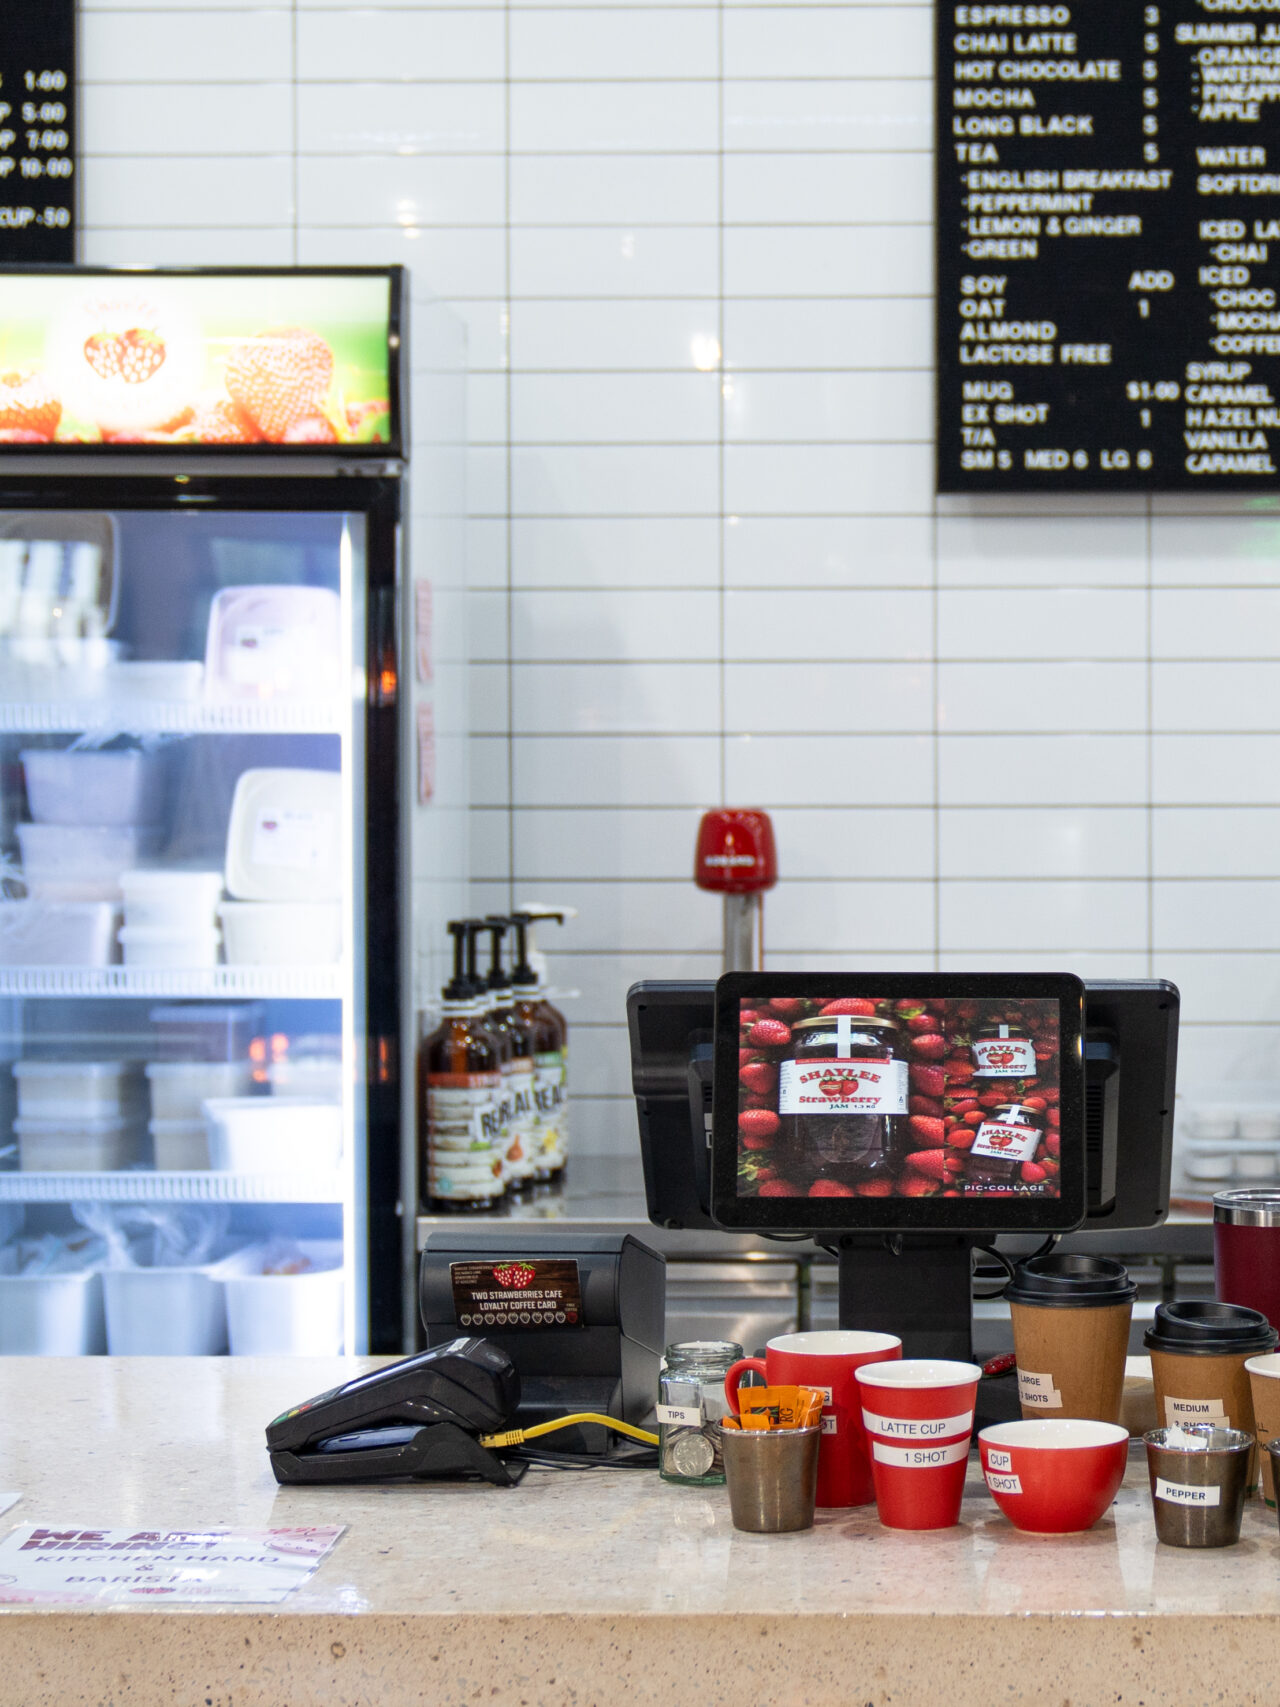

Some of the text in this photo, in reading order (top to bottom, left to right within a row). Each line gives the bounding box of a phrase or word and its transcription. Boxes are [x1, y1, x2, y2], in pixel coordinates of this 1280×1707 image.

[954, 5, 1070, 25] ESPRESSO
[954, 33, 1077, 53] CHAI LATTE
[1175, 23, 1256, 44] SUMMER
[954, 60, 1121, 80] HOT CHOCOLATE
[953, 88, 1035, 108] MOCHA
[1199, 102, 1260, 121] APPLE
[953, 116, 1094, 136] LONG BLACK
[955, 143, 999, 162] TEA
[1196, 146, 1266, 166] WATER
[967, 171, 1172, 190] ENGLISH BREAKFAST
[967, 193, 1094, 212] PEPPERMINT
[967, 216, 1141, 236] LEMON GINGER
[1200, 220, 1247, 240] ICED
[967, 240, 1038, 259] GREEN
[1214, 244, 1268, 263] CHAI
[960, 276, 1008, 295] SOY
[1128, 270, 1175, 291] ADD
[1199, 266, 1250, 286] ICED
[1214, 288, 1277, 308] CHOC
[959, 299, 1006, 318] OAT
[959, 321, 1057, 341] ALMOND
[959, 344, 1112, 364] LACTOSE FREE
[1186, 362, 1252, 381] SYRUP
[962, 381, 1014, 400] MUG
[1185, 385, 1275, 404] CARAMEL
[961, 403, 1050, 423] EX SHOT
[960, 427, 996, 447] T/A
[1184, 431, 1268, 450] VANILLA
[960, 450, 1130, 470] SM MED LG
[800, 1068, 881, 1084] SHAYLEE
[799, 1095, 881, 1105] Strawberry
[471, 1290, 563, 1300] TWO STRAWBERRIES CAFE
[479, 1301, 509, 1311] LOYALTY
[510, 1301, 536, 1310] COFFEE
[537, 1300, 557, 1309] CARD
[1020, 1374, 1041, 1386] LARGE
[1025, 1392, 1049, 1403] SHOTS
[667, 1410, 686, 1420] TIPS
[1173, 1402, 1210, 1413] MEDIUM
[880, 1422, 946, 1435] LATTE CUP
[913, 1450, 947, 1464] SHOT
[990, 1453, 1010, 1468] CUP
[995, 1476, 1018, 1491] SHOT
[1166, 1487, 1206, 1500] PEPPER
